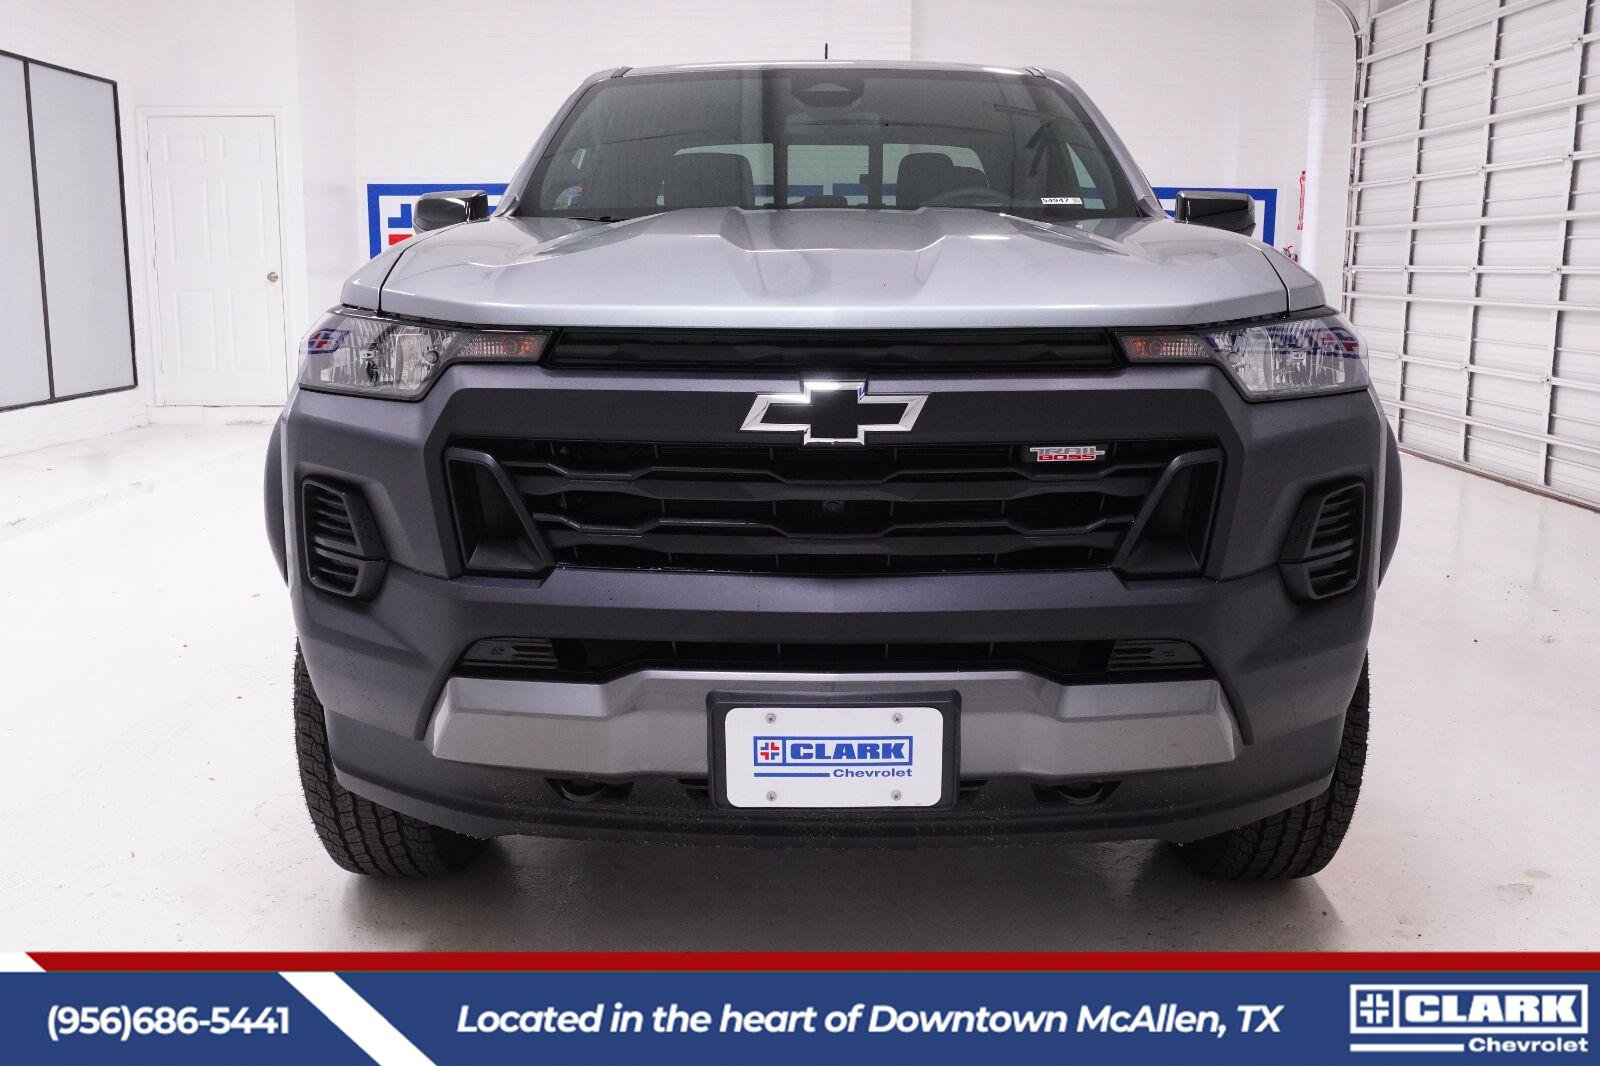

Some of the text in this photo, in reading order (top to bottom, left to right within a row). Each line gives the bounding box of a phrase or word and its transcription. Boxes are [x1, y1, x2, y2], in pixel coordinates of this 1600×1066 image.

[1030, 446, 1105, 455] TRAIL
[790, 743, 905, 760] CLARK
[833, 768, 913, 778] Chevrolet
